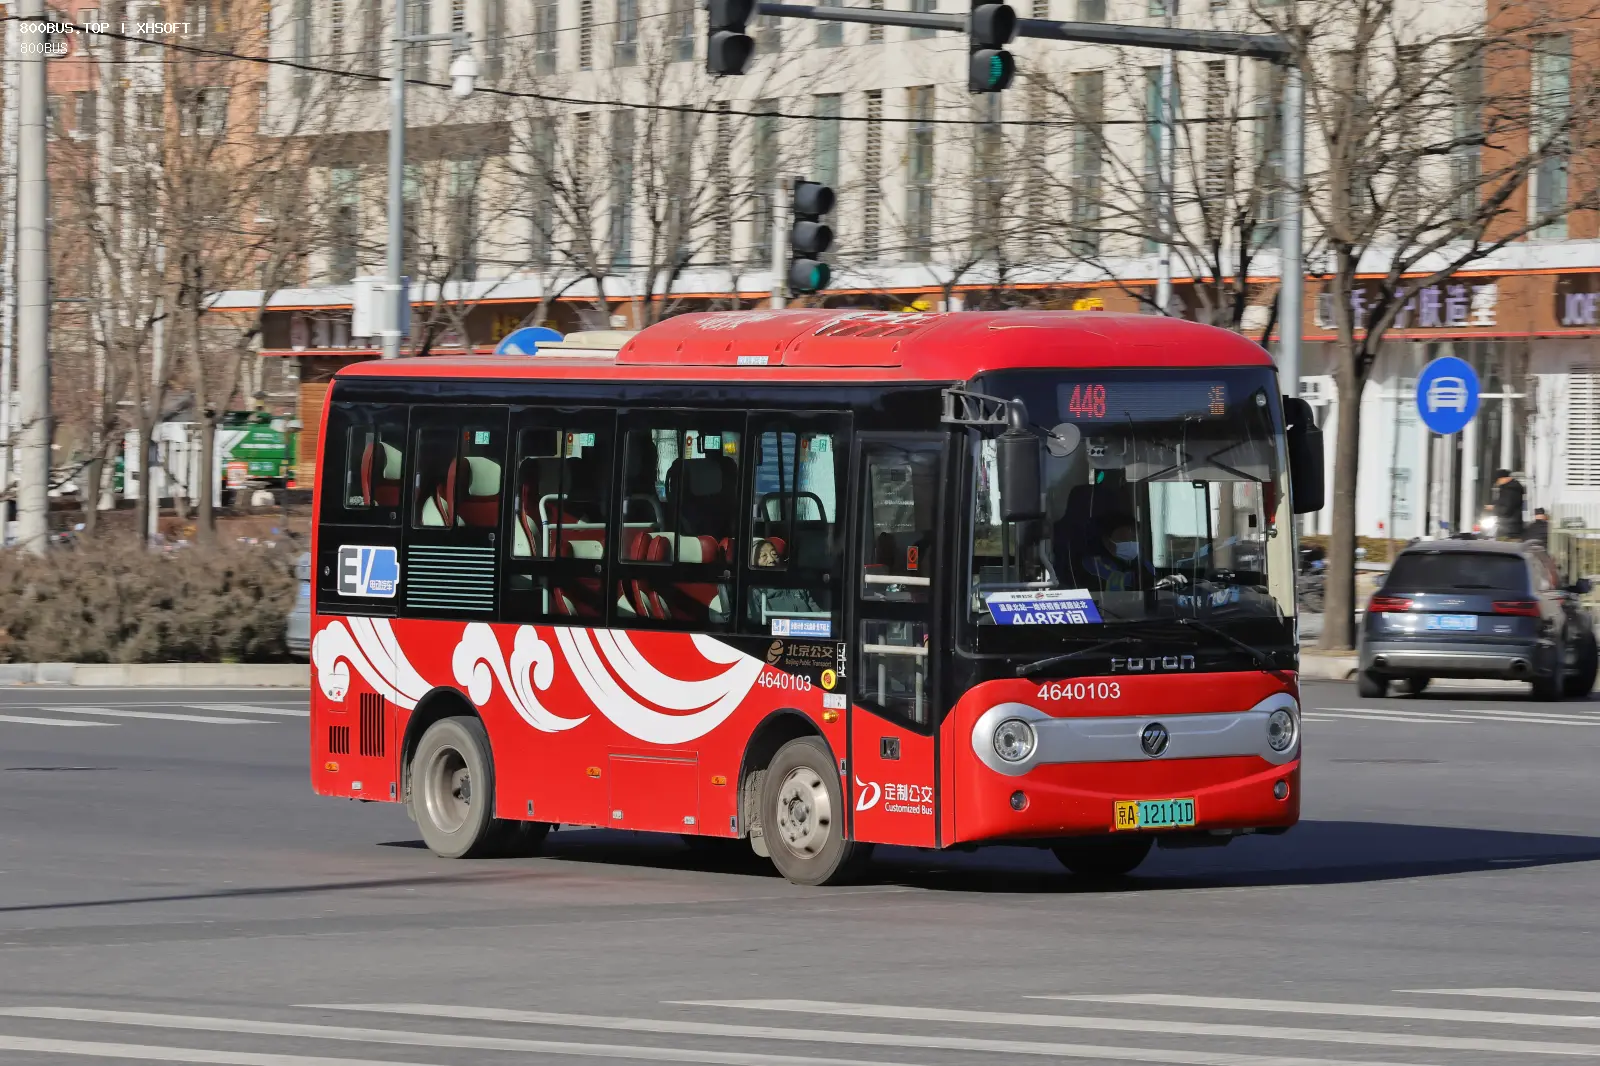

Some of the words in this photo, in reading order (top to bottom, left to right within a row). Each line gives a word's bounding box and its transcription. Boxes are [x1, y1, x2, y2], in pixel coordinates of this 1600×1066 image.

[1069, 384, 1107, 418] 448
[1012, 610, 1089, 625] 448区间
[786, 644, 834, 658] 北京公交
[785, 658, 799, 667] Beijing
[799, 659, 811, 667] Public
[812, 660, 832, 668] Transport
[1111, 654, 1195, 672] FOTON
[758, 671, 812, 692] 4640103
[1037, 682, 1121, 701] 4640103
[884, 783, 933, 803] 定制公交
[884, 802, 920, 814] Customized
[921, 804, 933, 815] Bus
[1118, 805, 1136, 825] 京A
[1143, 802, 1194, 824] 12111D
